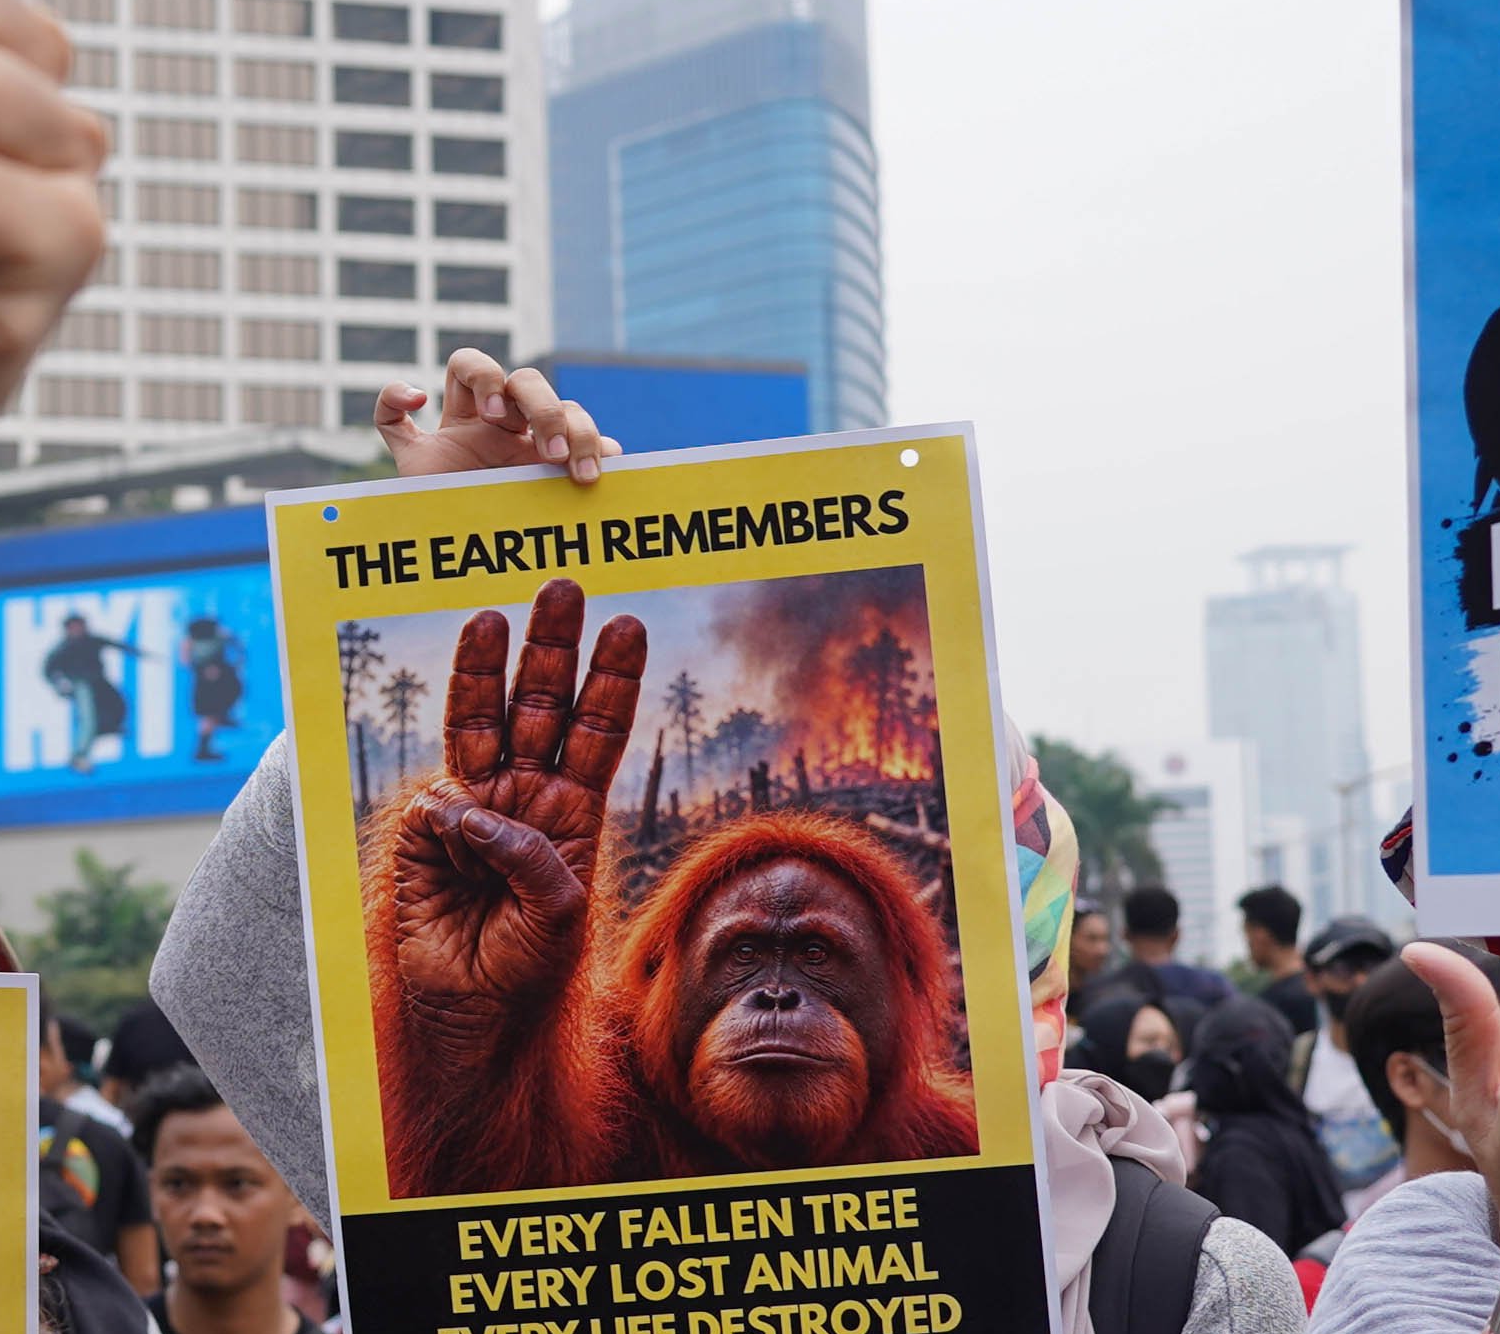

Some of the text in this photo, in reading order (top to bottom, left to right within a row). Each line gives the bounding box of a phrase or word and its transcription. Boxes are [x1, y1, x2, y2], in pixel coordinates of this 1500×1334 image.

[326, 489, 910, 589] THE EARTH REMEMBERS
[457, 1187, 920, 1261] EVERY FALLEN TREE
[448, 1241, 940, 1314] EVERY LOST ANIMAL
